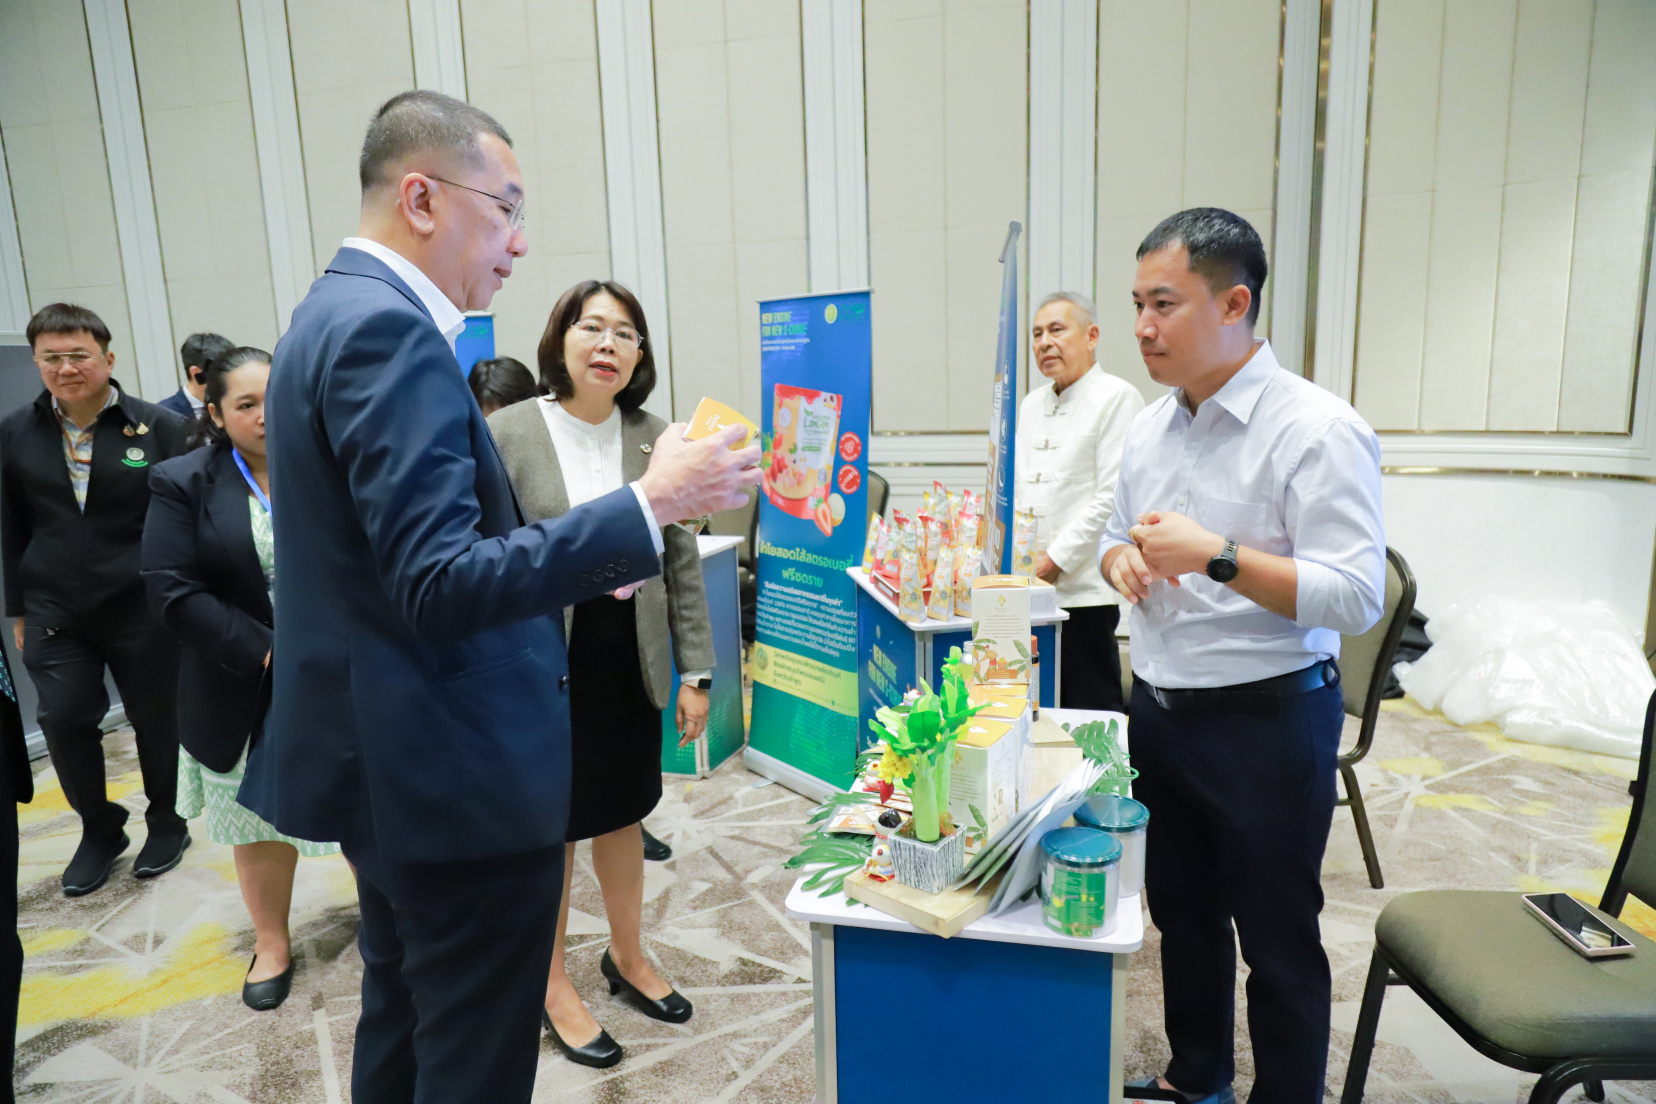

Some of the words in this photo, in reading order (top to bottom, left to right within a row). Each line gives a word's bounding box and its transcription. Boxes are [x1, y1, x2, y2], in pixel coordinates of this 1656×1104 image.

[762, 314, 772, 324] NEW
[774, 312, 792, 323] ENGINE
[762, 326, 771, 336] FOR
[772, 325, 782, 336] NEW
